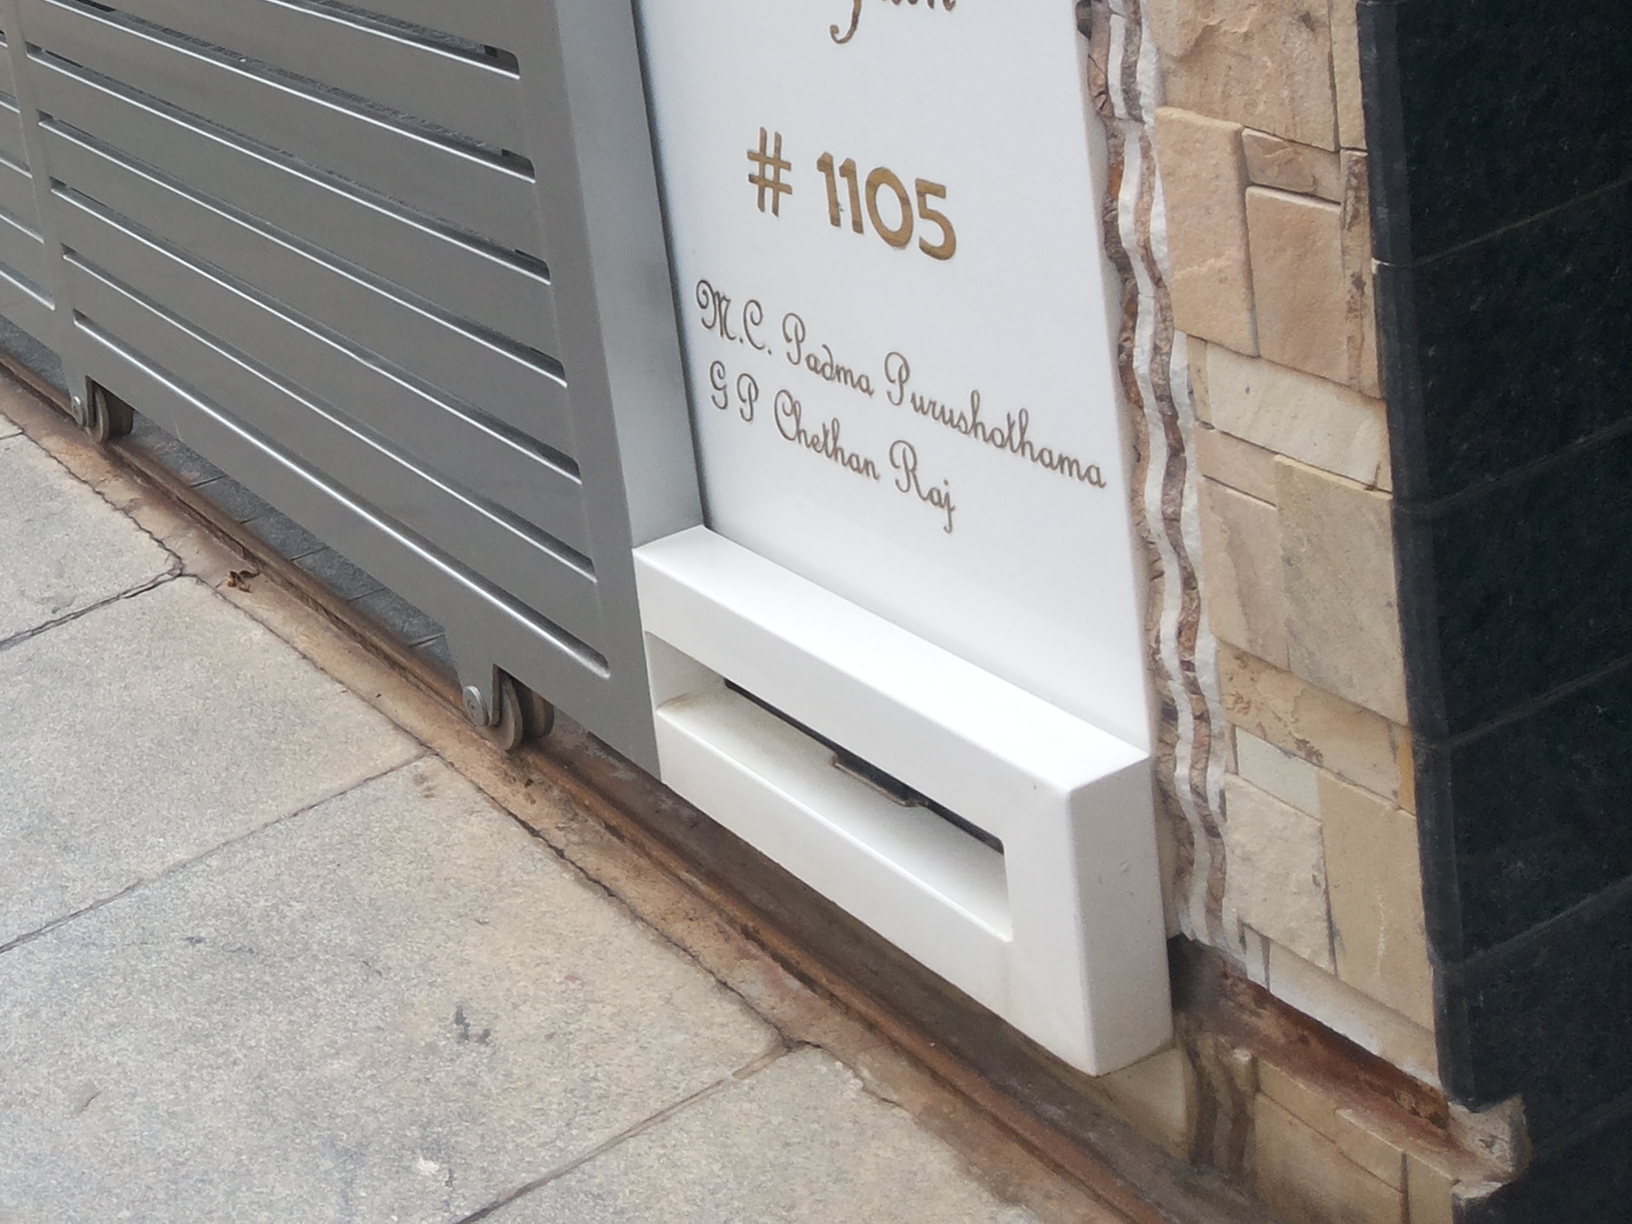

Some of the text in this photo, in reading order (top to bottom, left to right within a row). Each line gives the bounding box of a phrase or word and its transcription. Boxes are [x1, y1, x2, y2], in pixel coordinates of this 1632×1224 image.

[747, 126, 957, 262] # 1105
[774, 389, 880, 482] Chethan
[889, 439, 956, 535] Raj
[782, 312, 875, 398] Padma
[884, 351, 1108, 490] Purushothama
